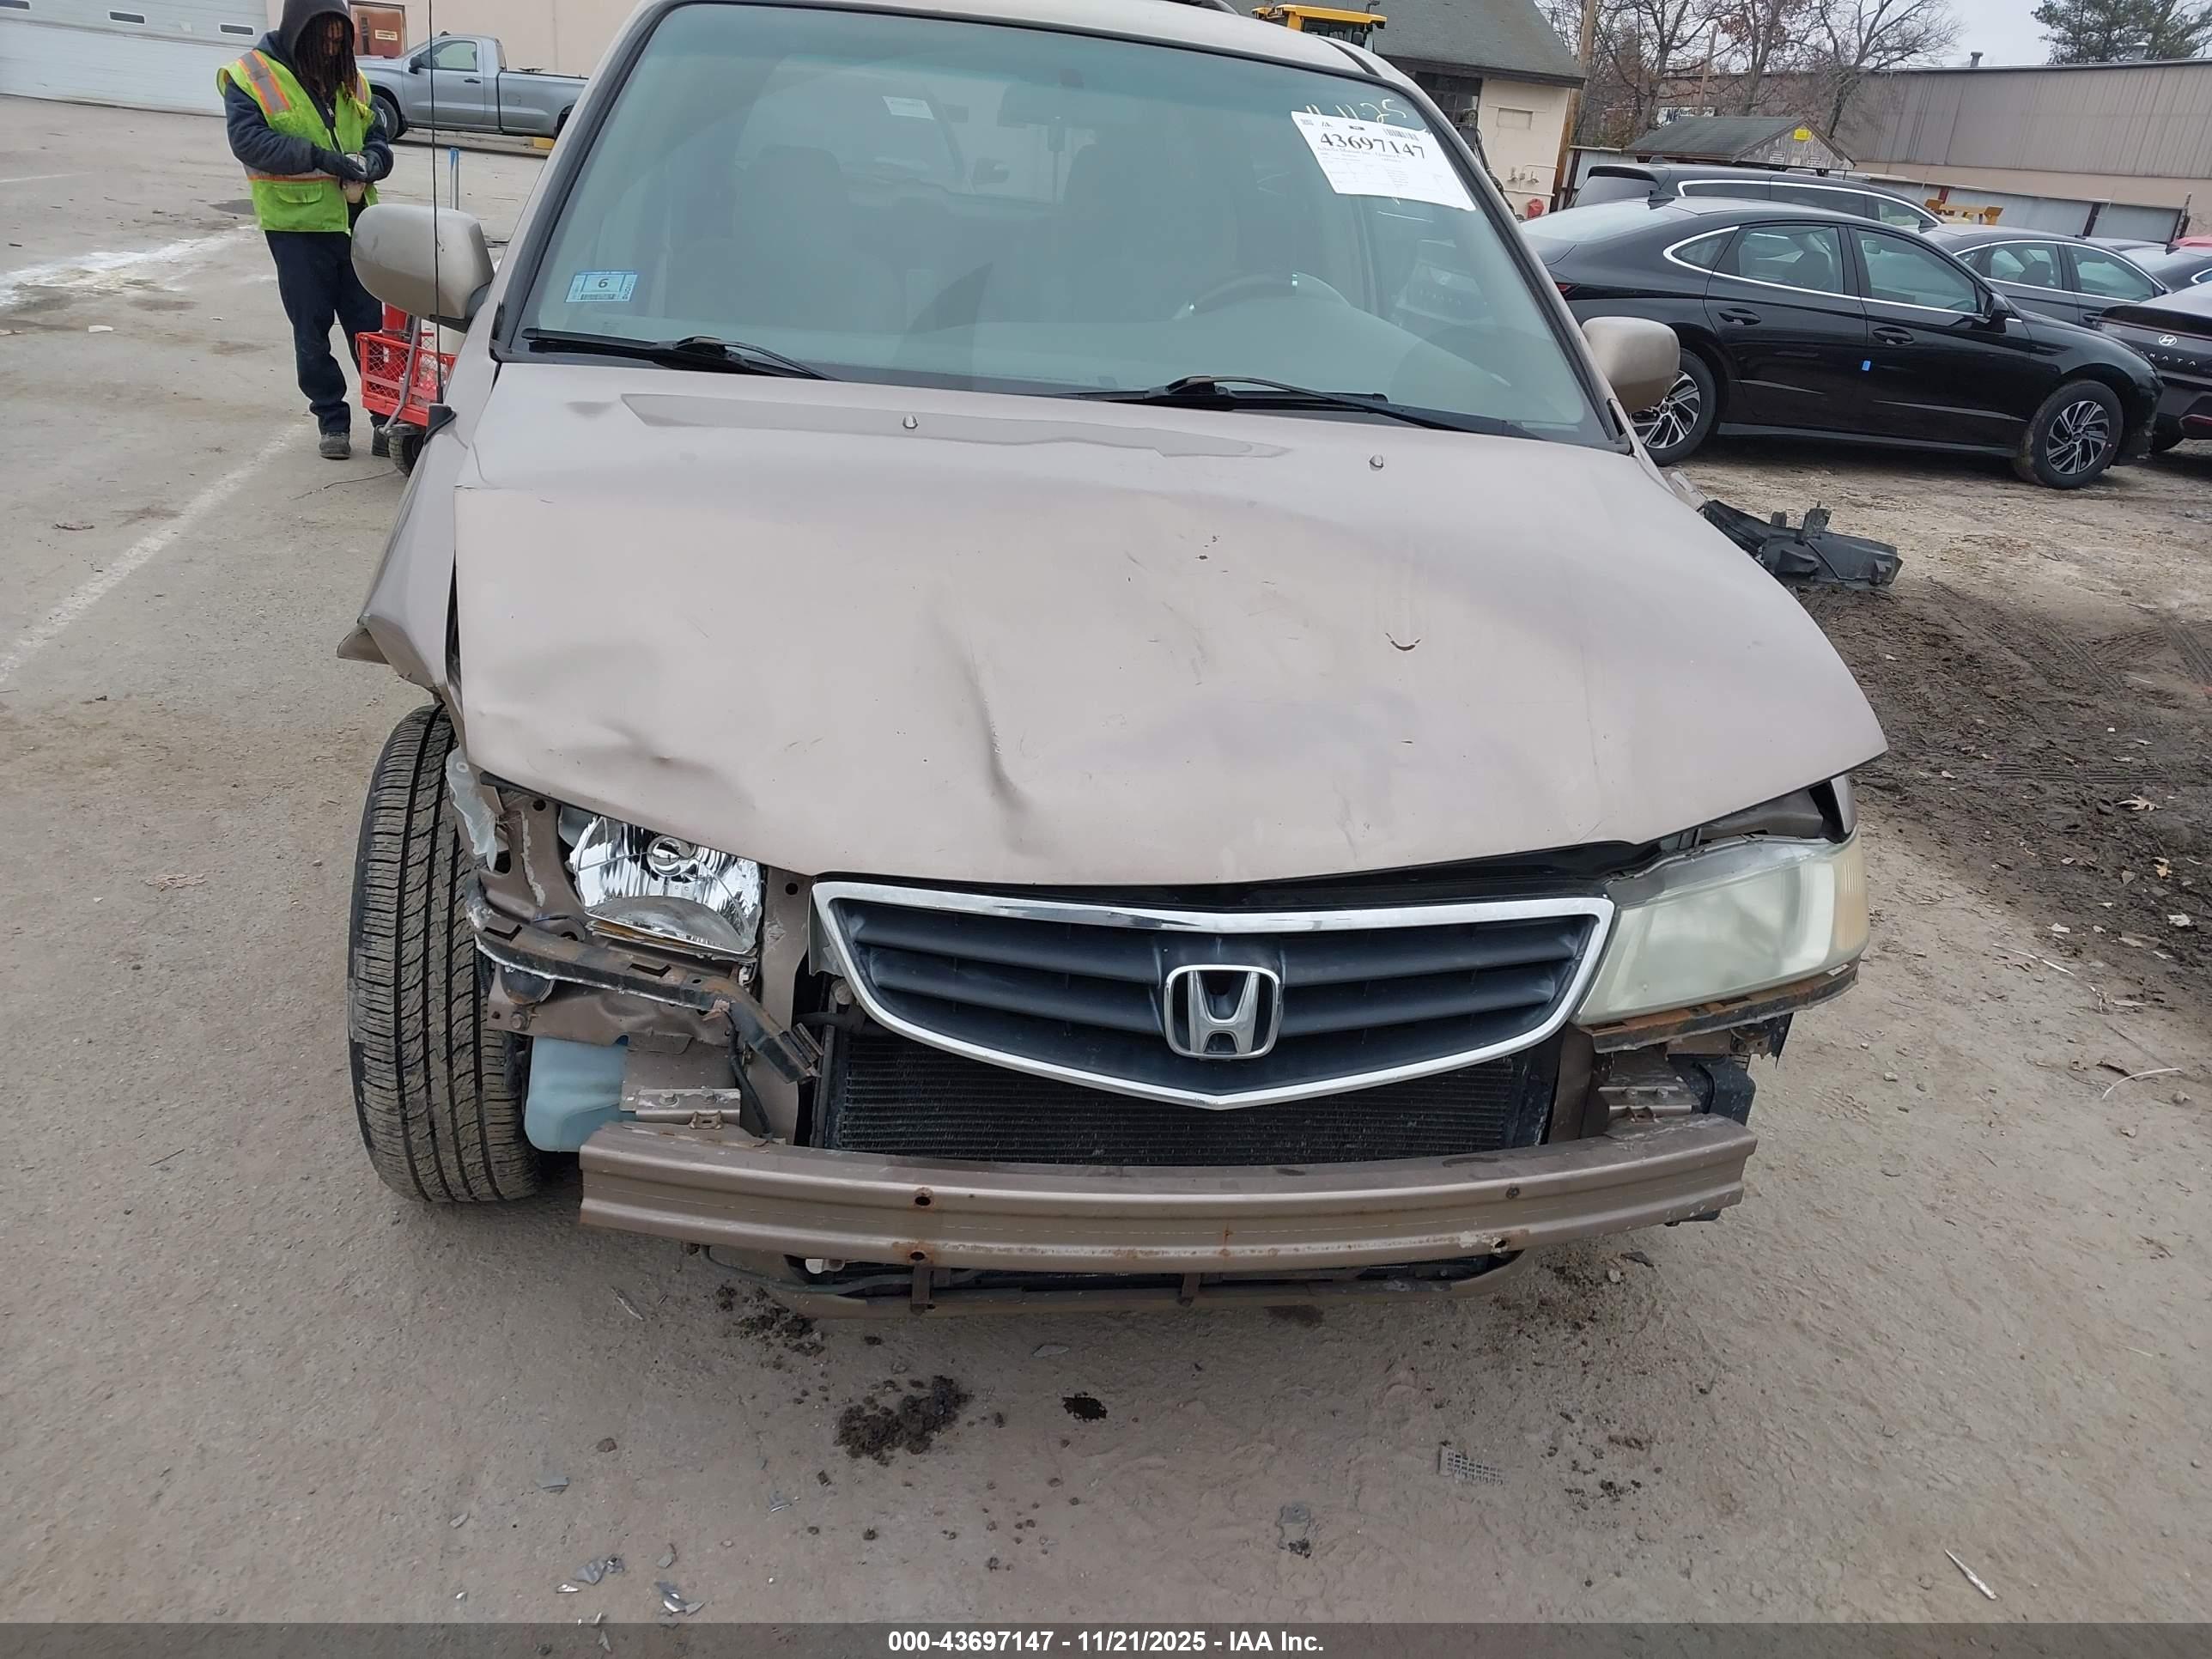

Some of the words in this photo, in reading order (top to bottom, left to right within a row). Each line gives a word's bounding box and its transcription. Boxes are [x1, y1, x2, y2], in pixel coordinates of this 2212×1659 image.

[1320, 132, 1425, 159] 43697147
[598, 278, 610, 289] 6
[2140, 350, 2197, 367] NATA
